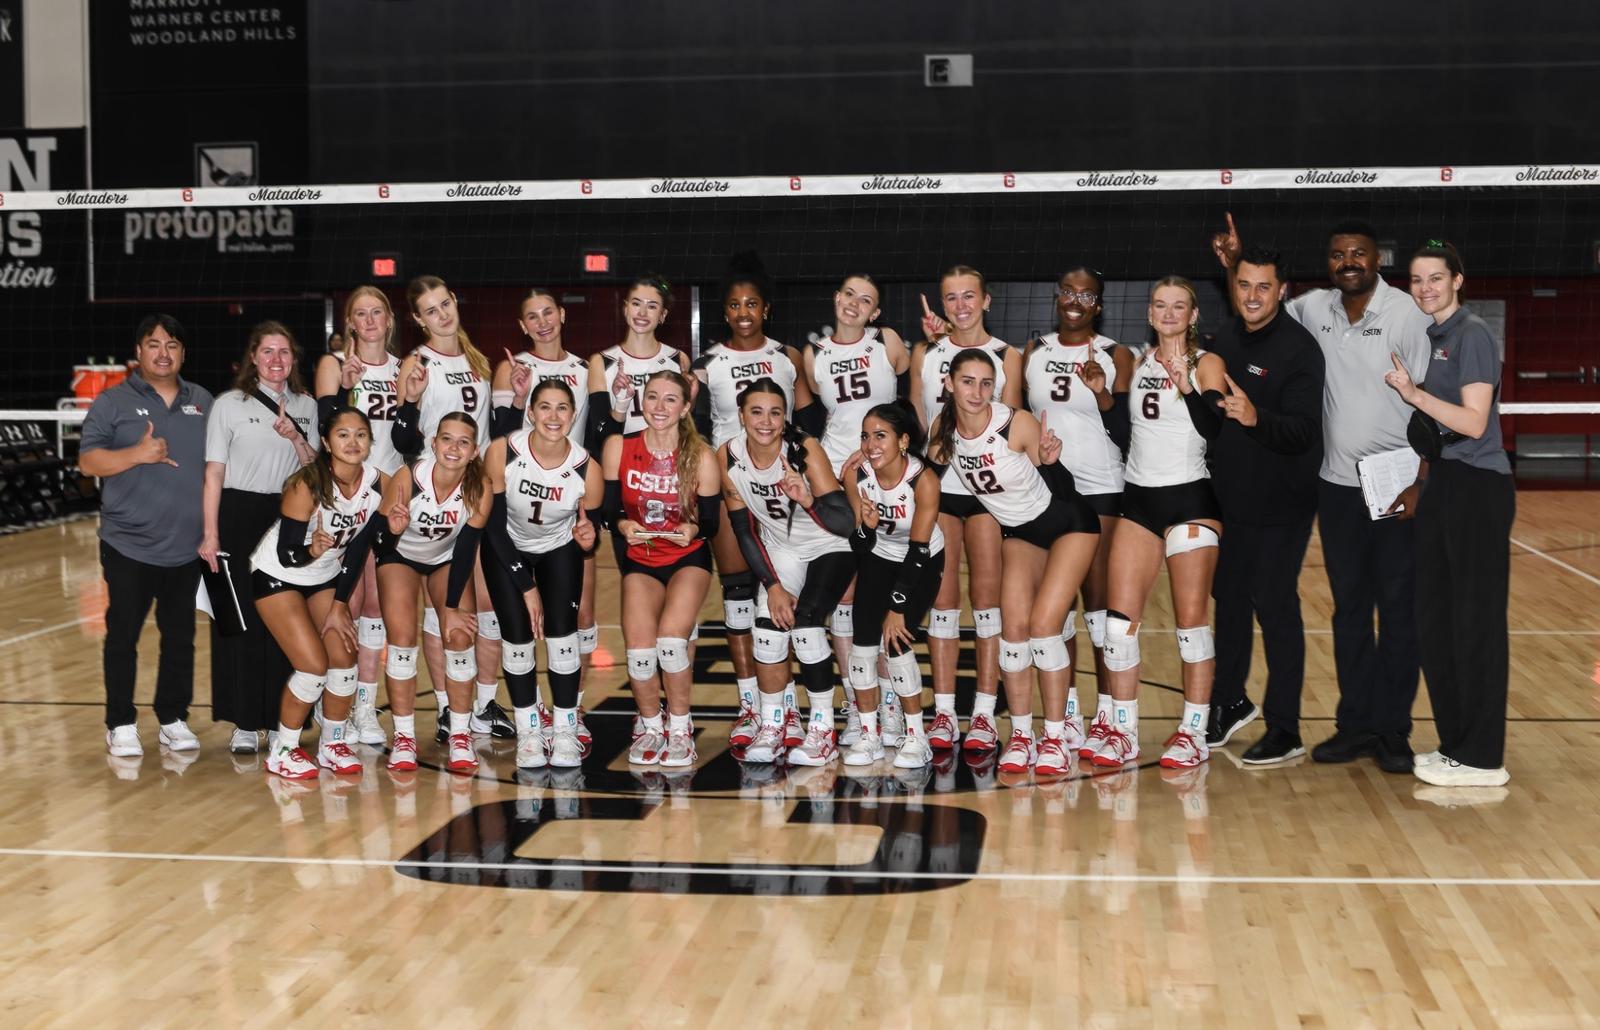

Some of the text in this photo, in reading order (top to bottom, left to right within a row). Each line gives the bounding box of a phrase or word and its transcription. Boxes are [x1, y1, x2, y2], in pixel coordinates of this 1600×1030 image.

[130, 8, 281, 27] WARNER CENTER
[130, 26, 297, 46] WOODLAND HILLS
[57, 192, 128, 205] Matadors
[249, 187, 321, 201] Matadors
[447, 183, 522, 197] Matadors
[651, 180, 729, 194] Matadors
[861, 176, 941, 190] Matadors
[1076, 173, 1158, 187] Matadors
[1294, 170, 1377, 184] Matadors
[1515, 167, 1598, 181] Matadors
[0, 211, 42, 257] S
[0, 259, 57, 288] tion
[731, 361, 773, 379] CSUN
[830, 355, 871, 375] CSUN
[461, 386, 478, 413] 9
[833, 371, 872, 404] 15
[1050, 376, 1071, 402] 3
[368, 393, 398, 421] 22
[1142, 392, 1160, 420] 6
[958, 453, 995, 470] CSUN
[518, 479, 564, 502] CSUN
[965, 470, 1006, 496] 12
[330, 508, 368, 529] CSUN
[417, 510, 459, 526] CSUN
[528, 500, 544, 526] 1
[765, 499, 788, 520] 5
[876, 502, 906, 519] SUN
